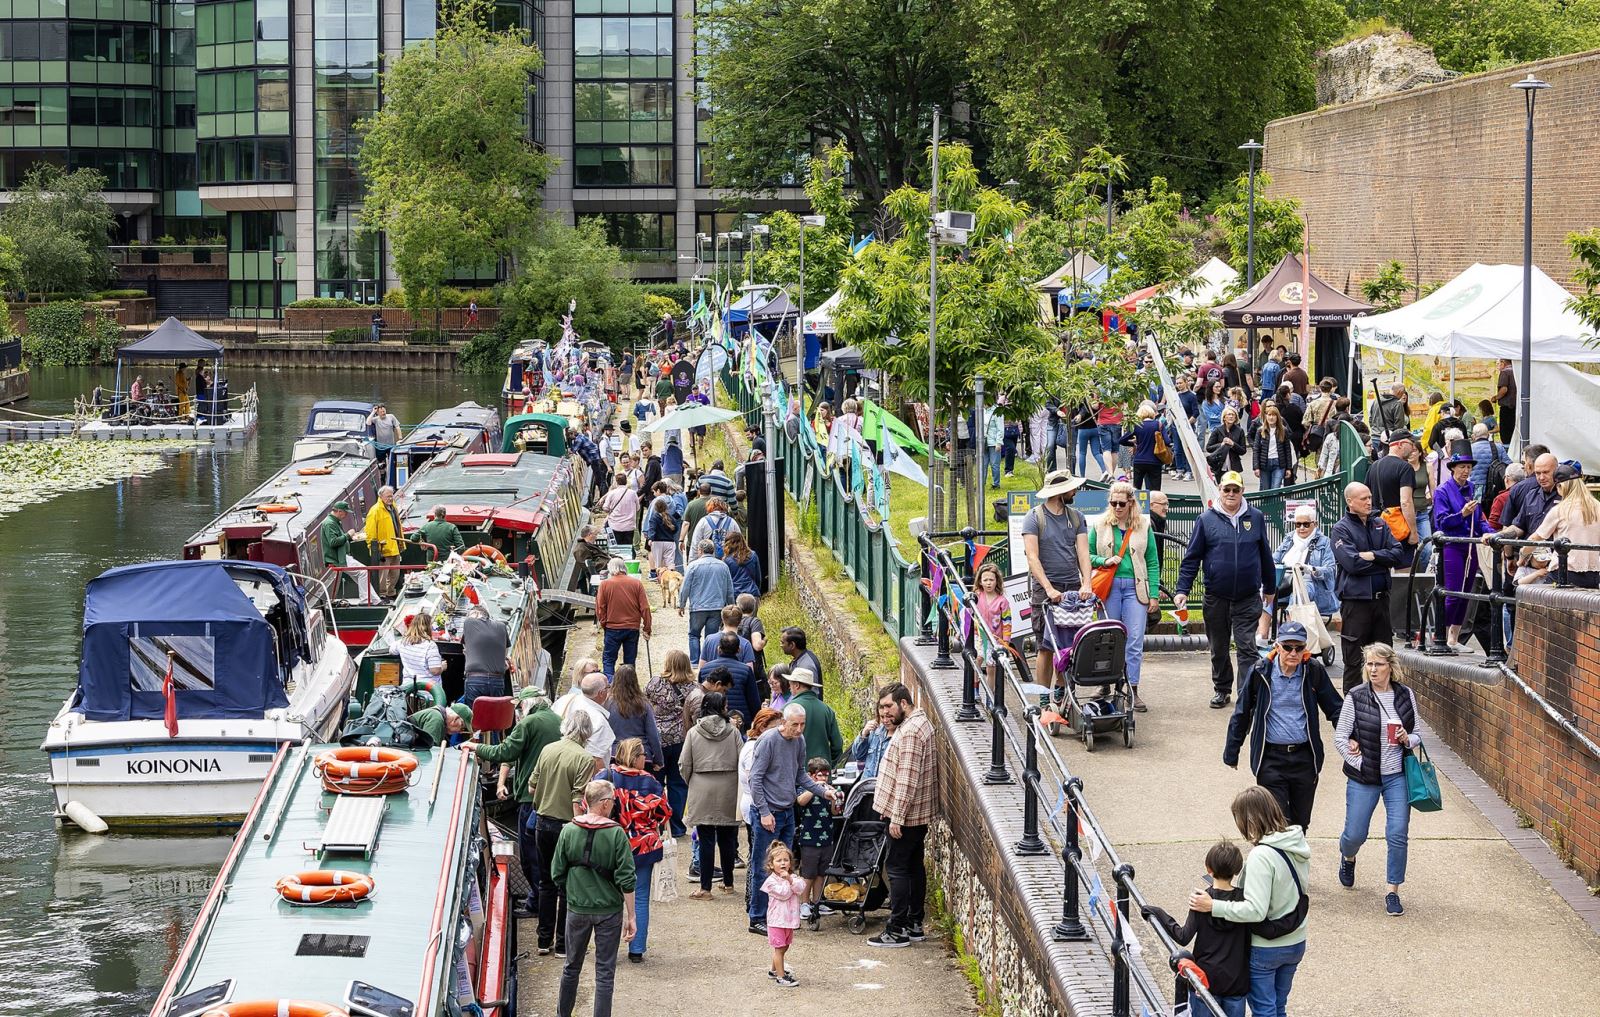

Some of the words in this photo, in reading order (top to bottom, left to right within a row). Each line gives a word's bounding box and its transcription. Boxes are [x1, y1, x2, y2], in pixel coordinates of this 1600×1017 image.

[1256, 314, 1282, 322] Painted
[1283, 314, 1297, 323] Dog
[127, 758, 222, 774] KOINONIA
